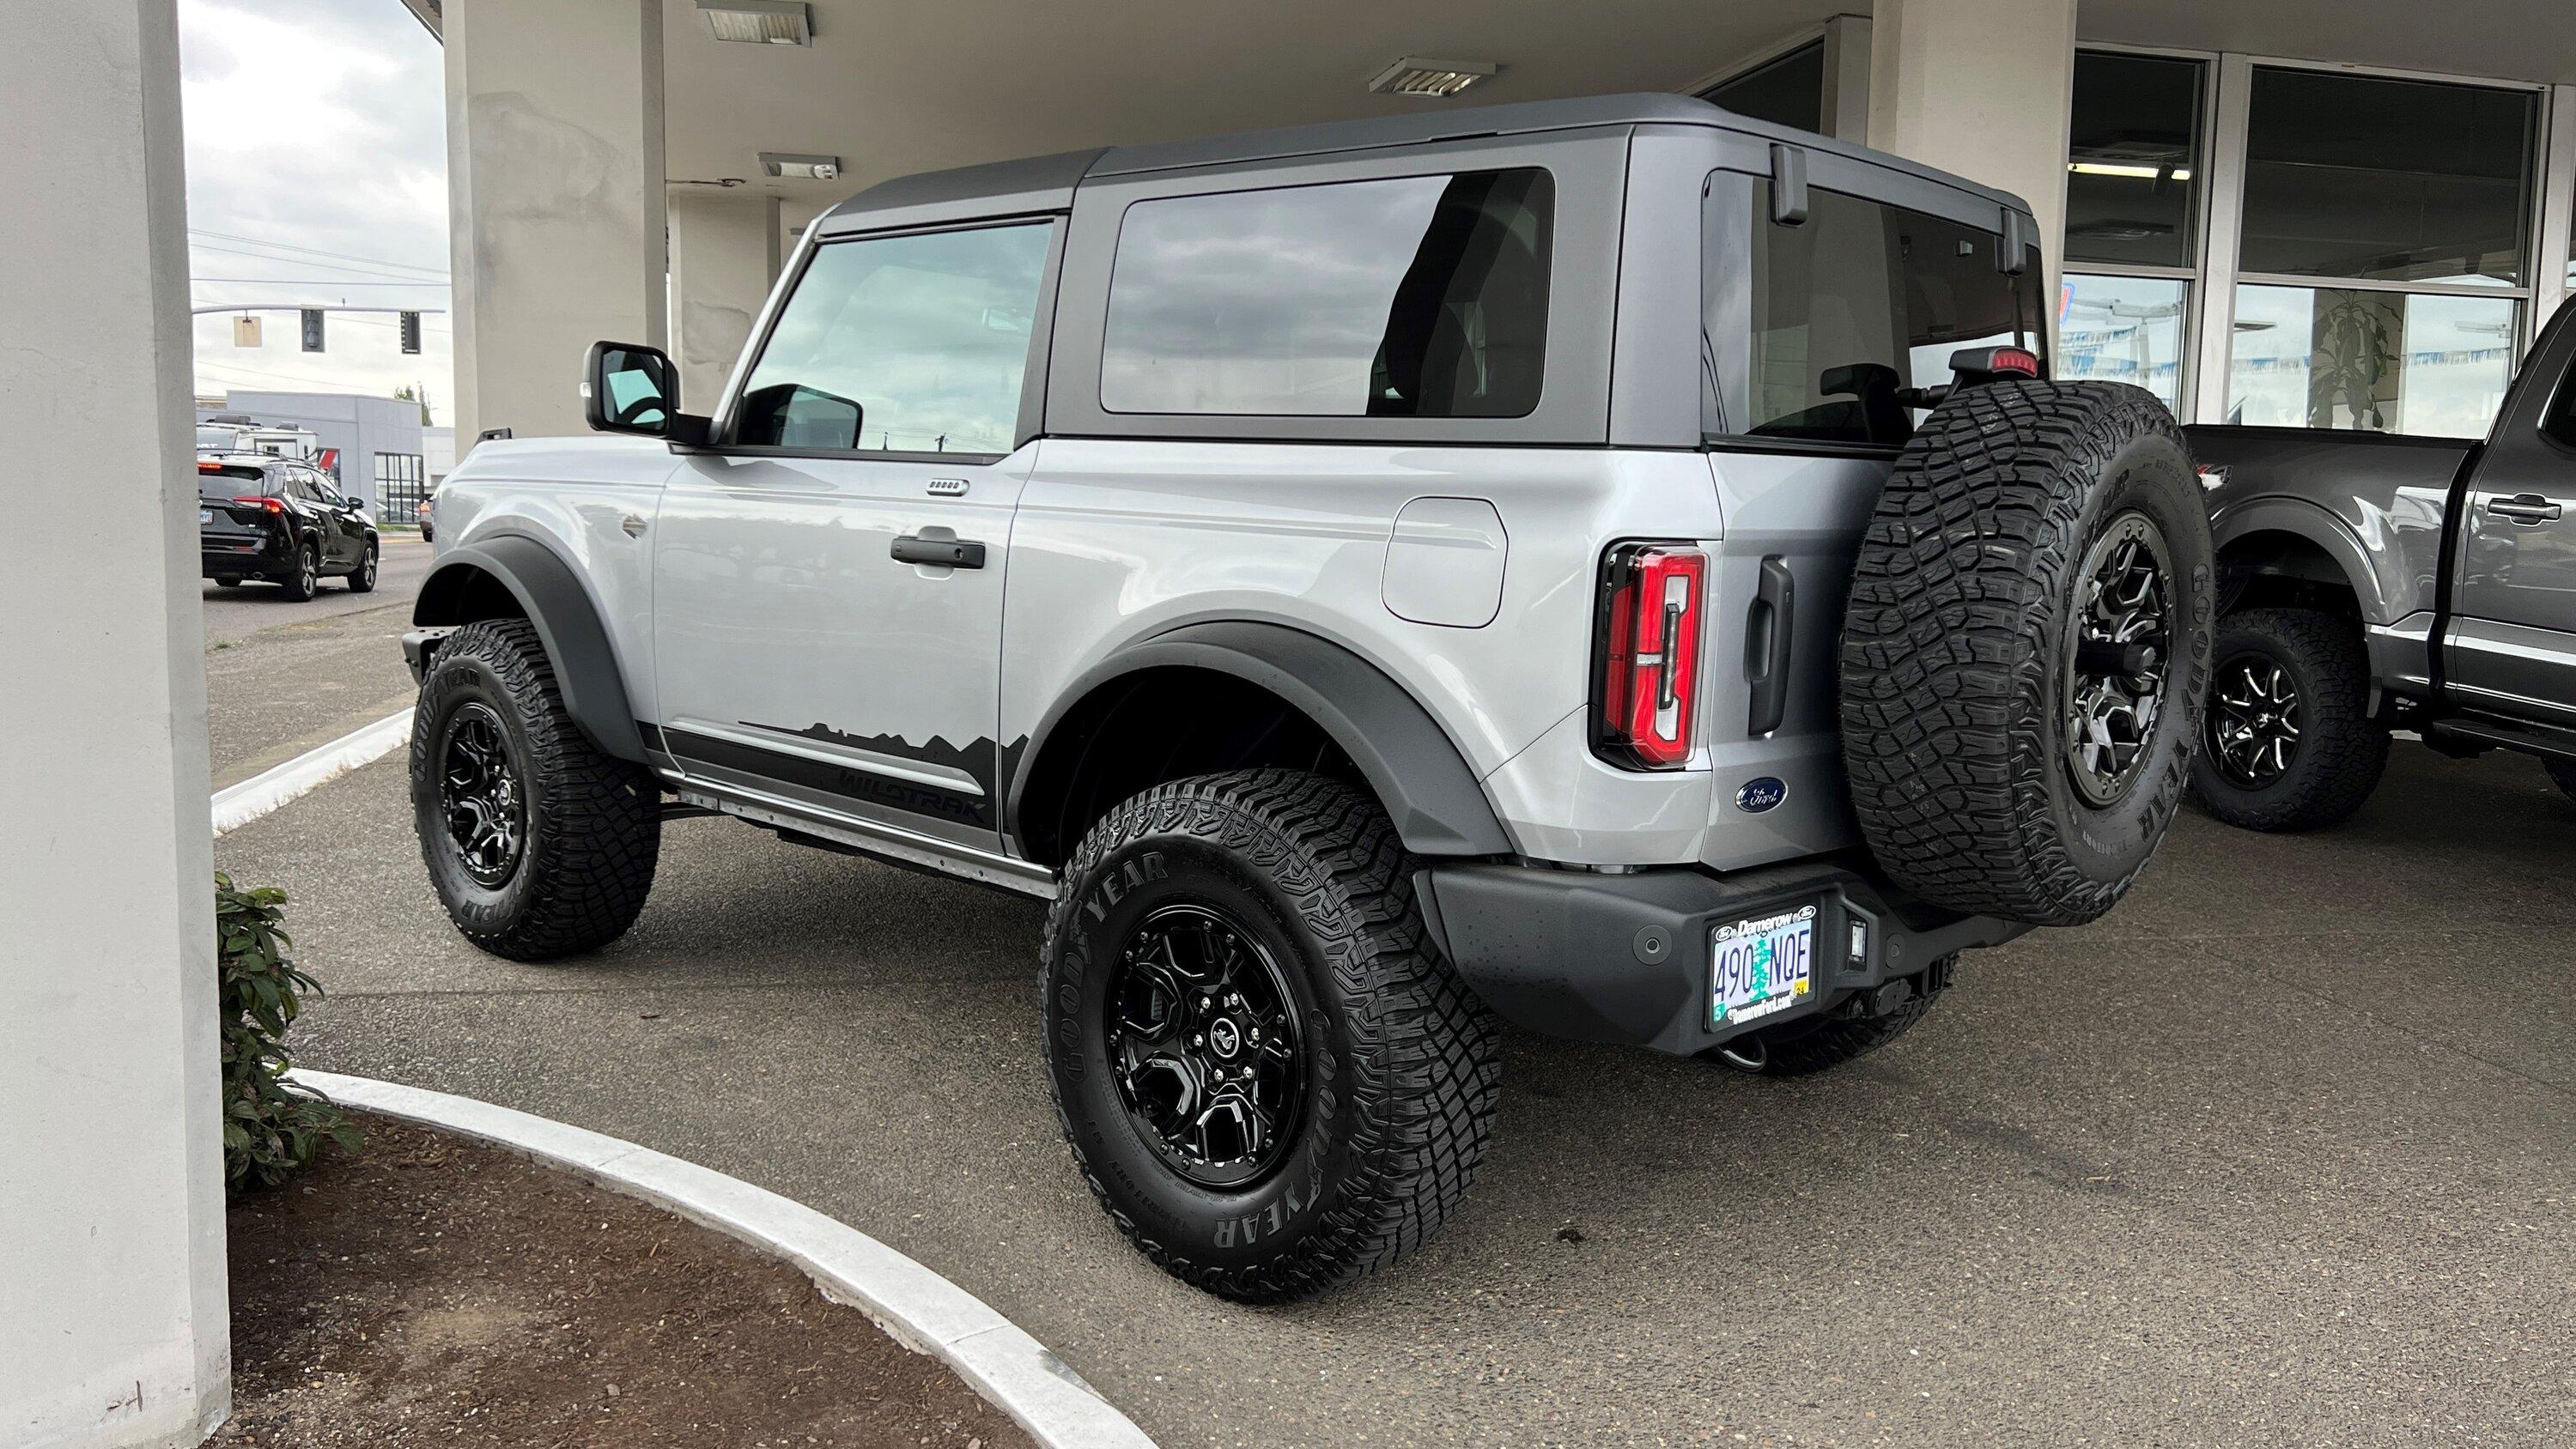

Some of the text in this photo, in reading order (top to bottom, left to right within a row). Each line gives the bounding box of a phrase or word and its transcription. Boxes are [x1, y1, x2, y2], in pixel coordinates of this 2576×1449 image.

[1085, 851, 1169, 925] YEAR
[1737, 912, 1793, 937] Damerow
[1715, 929, 1810, 1002] 490 NQE
[1213, 1181, 1303, 1250] YEAR
